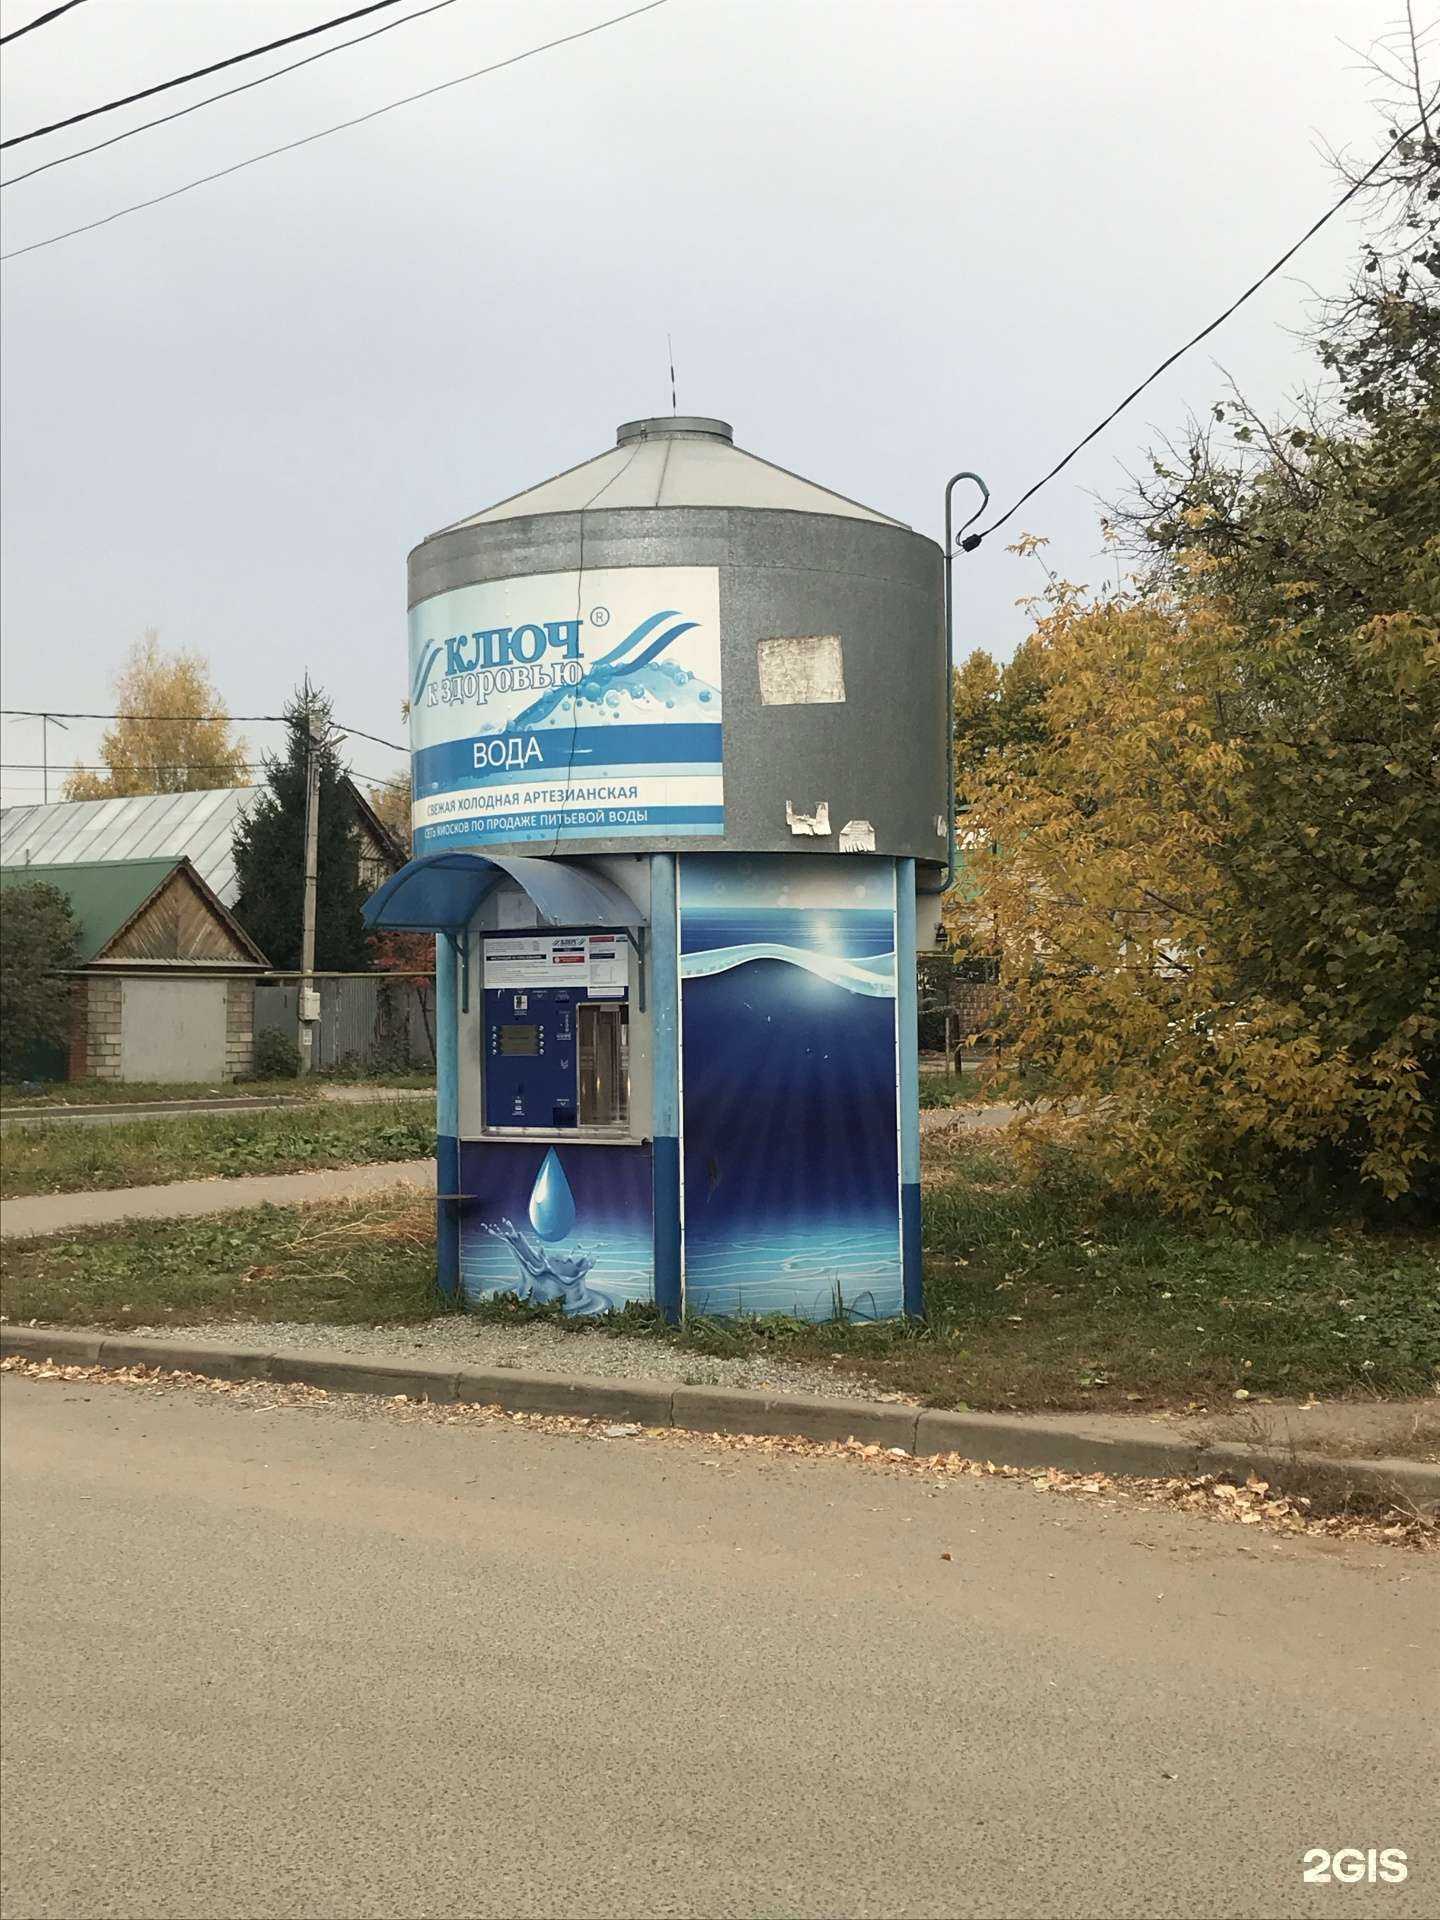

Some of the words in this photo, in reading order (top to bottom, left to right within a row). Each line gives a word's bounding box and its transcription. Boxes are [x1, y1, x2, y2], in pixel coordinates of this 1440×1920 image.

[473, 736, 543, 770] ВОДА
[427, 801, 456, 817] СВЕЖАЯ
[458, 792, 520, 811] ХОЛОДНАЯ
[523, 786, 638, 804] АРТЕЗИАНСКАЯ
[437, 822, 470, 837] КИОСКОВ
[471, 820, 485, 832] ПО
[486, 815, 537, 830] ПРОДАЖЕ
[540, 811, 604, 826] ПИТЬЕВОЙ
[609, 810, 649, 822] ВОДЫ
